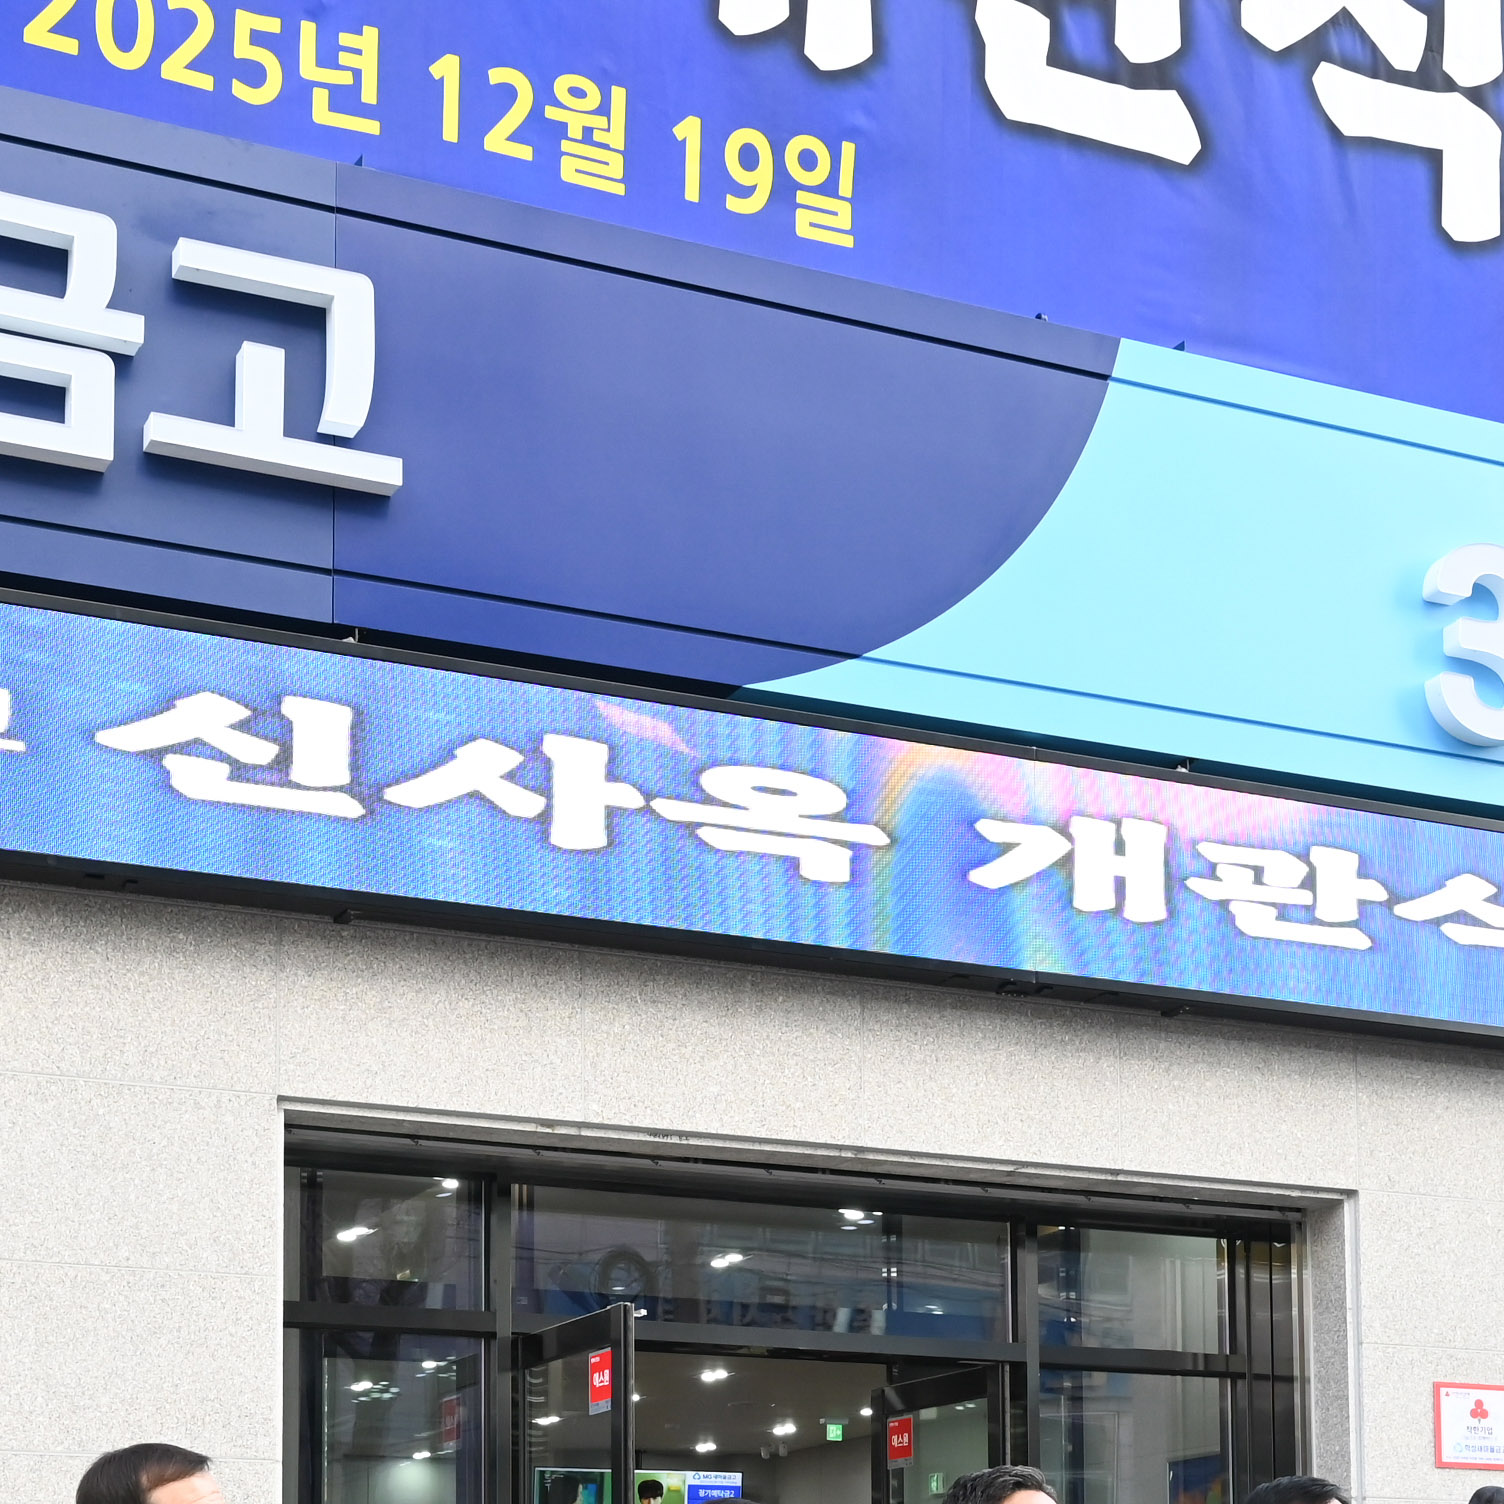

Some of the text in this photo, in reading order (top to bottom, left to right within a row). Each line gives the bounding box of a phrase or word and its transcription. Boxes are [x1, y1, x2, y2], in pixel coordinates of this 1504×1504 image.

[23, 0, 856, 248] 2025년 12월 19일
[95, 691, 889, 884] 신사옥
[592, 1369, 610, 1388] 에스원
[891, 1432, 909, 1448] 에스원
